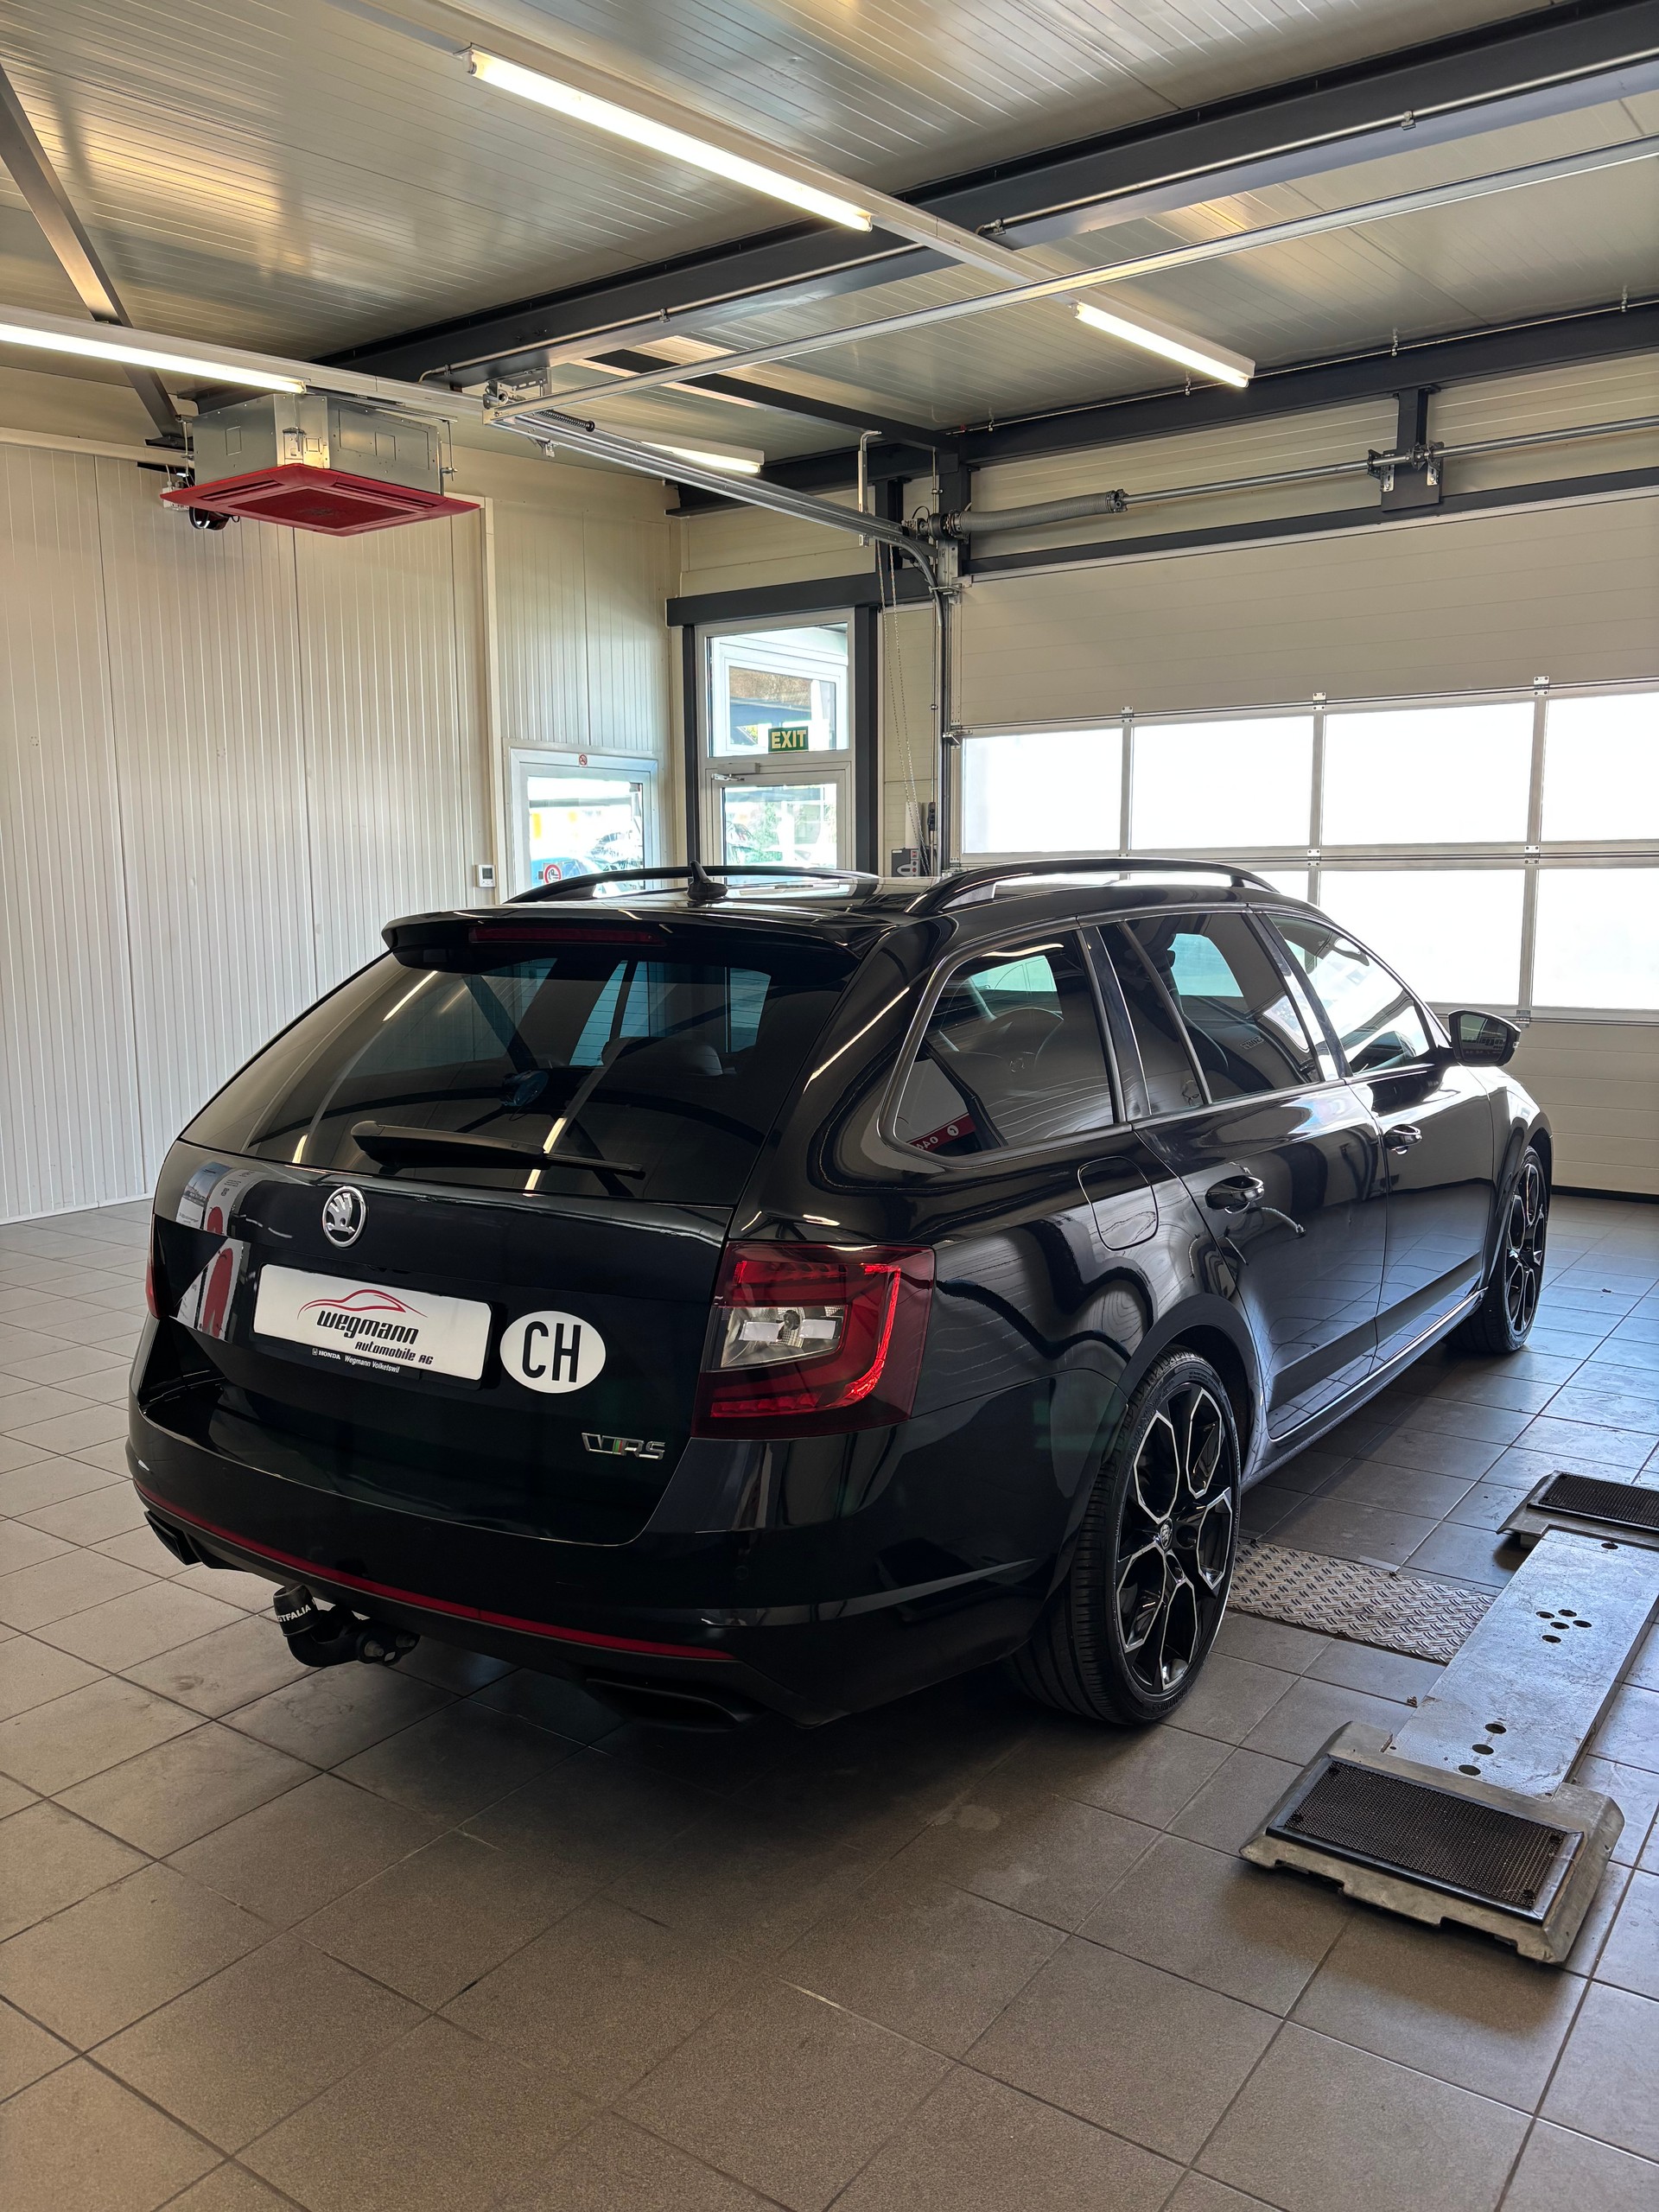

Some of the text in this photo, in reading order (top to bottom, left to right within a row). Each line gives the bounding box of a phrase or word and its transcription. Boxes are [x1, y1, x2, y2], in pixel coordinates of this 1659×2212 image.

[771, 729, 807, 749] EXIT
[316, 1310, 420, 1344] wegmann
[318, 1350, 400, 1374] HONDA Wegmann Volketswil
[418, 1354, 434, 1365] AG
[522, 1320, 582, 1382] CH
